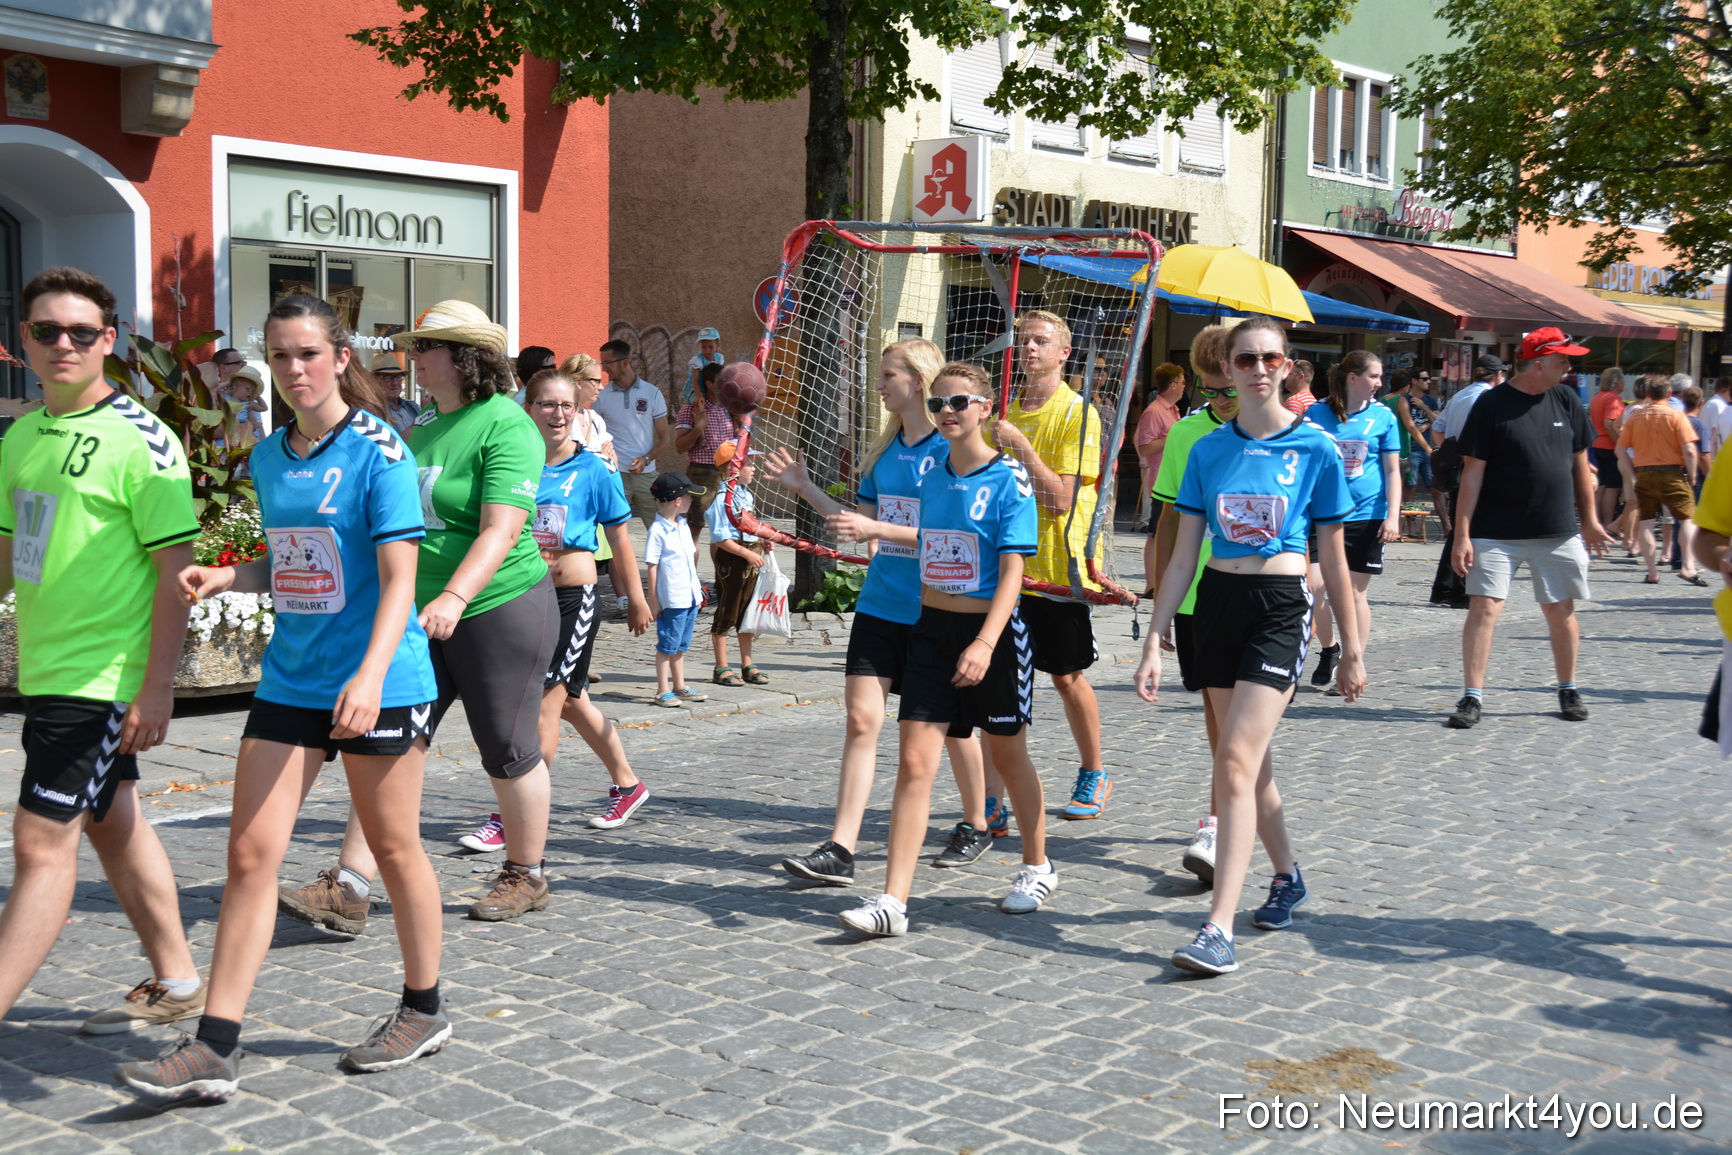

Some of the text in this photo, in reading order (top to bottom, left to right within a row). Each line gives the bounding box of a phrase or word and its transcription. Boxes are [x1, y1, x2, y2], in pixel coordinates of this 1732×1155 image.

[287, 189, 443, 245] fielmann
[1004, 186, 1199, 244] STADT APOTHEKE
[38, 426, 69, 438] hummel
[1362, 417, 1376, 436] 7
[60, 432, 101, 478] 13
[898, 454, 917, 462] hummel
[1243, 447, 1272, 457] hummel
[287, 469, 315, 479] hummel
[1277, 449, 1300, 485] 3
[317, 467, 343, 514] 2
[560, 471, 579, 498] 4
[969, 486, 992, 521] 8
[880, 546, 915, 556] NEUMARKT
[926, 567, 972, 577] FRESSNAPF
[276, 578, 333, 590] FRESSNAPF
[286, 600, 329, 611] NEUMARKT
[756, 591, 787, 617] H&M
[1261, 662, 1290, 677] hummel
[988, 715, 1017, 723] hummel
[33, 783, 78, 806] hummel
